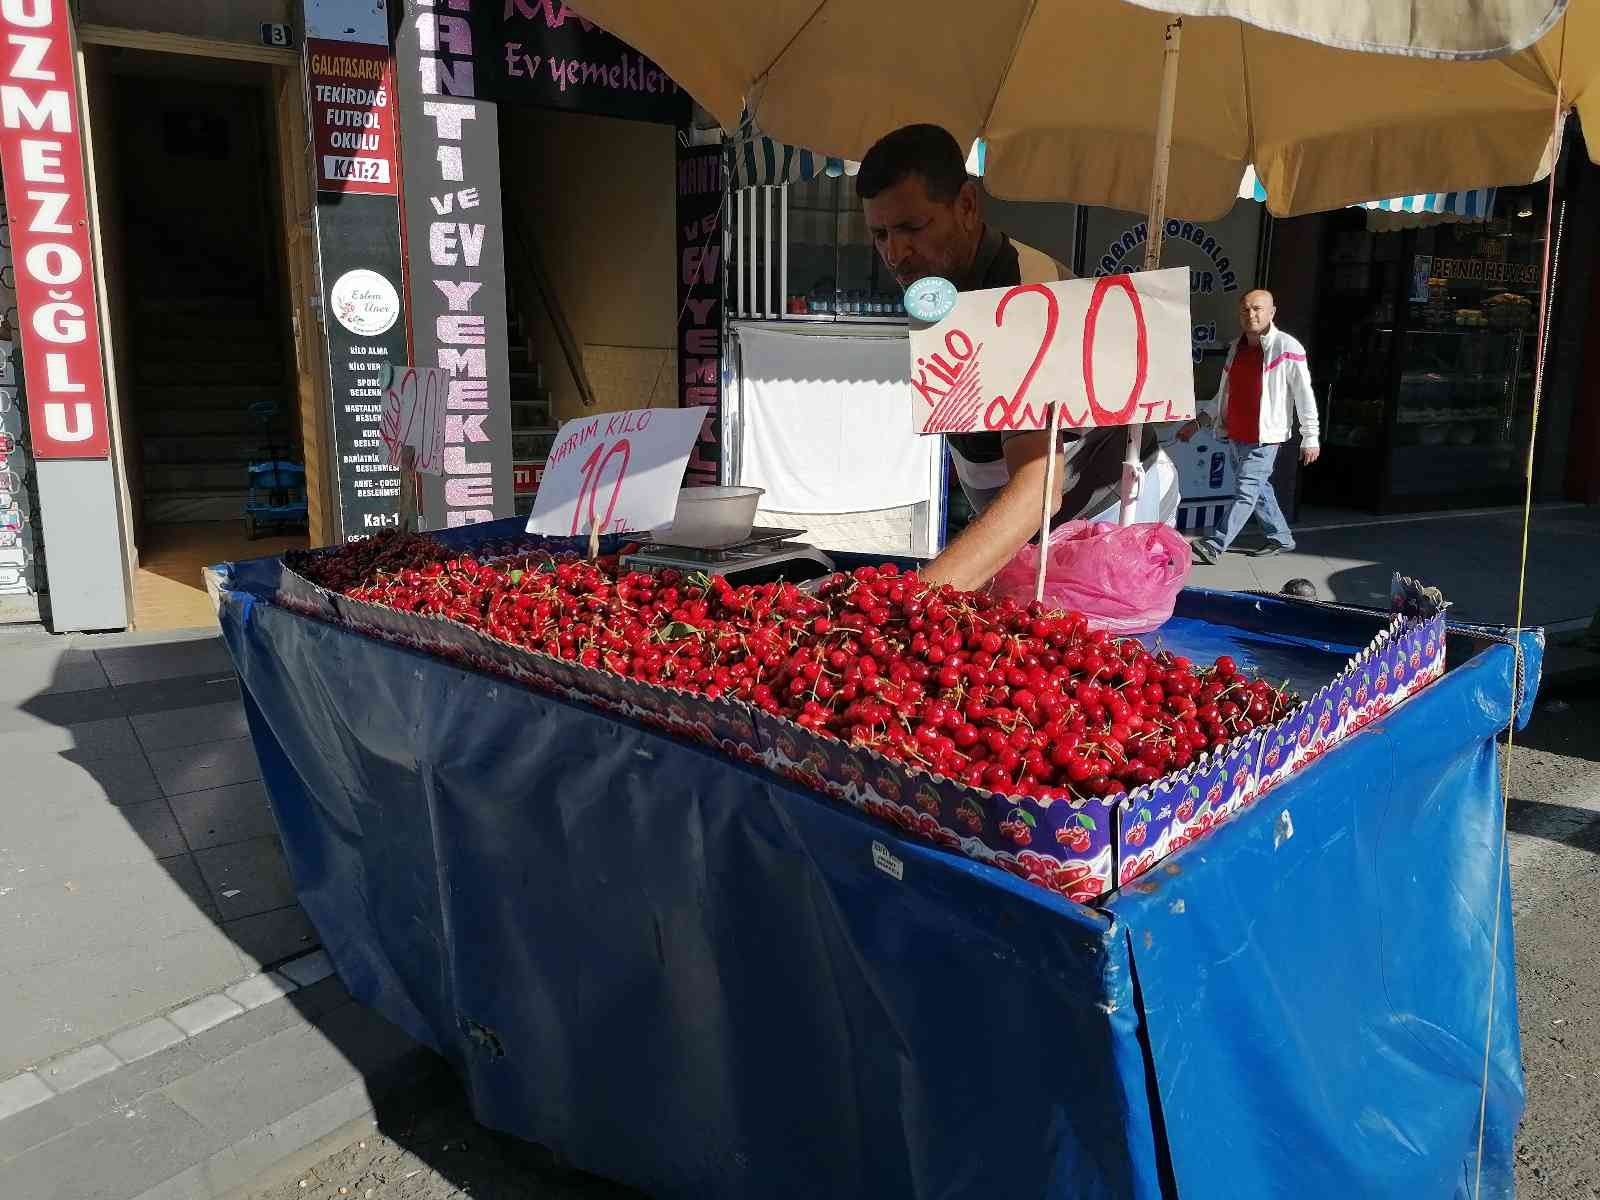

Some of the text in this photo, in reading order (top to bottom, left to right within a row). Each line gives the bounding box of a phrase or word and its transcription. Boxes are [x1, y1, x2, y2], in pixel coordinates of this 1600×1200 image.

[312, 54, 387, 81] GALATASARAY
[504, 42, 679, 94] Ev yemekler
[315, 82, 387, 108] TEKİRDAĞ
[326, 109, 381, 129] FUTBOL
[331, 132, 380, 151] OKULU
[333, 160, 381, 180] KAT:2
[430, 187, 481, 216] VE
[428, 222, 486, 267] EV
[350, 345, 389, 356] KİLO ALMA
[984, 273, 1148, 431] 20
[348, 361, 365, 371] KİLO
[549, 410, 653, 470] YARIM KİLO
[569, 438, 632, 537] 10
[364, 512, 400, 527] Kat-1
